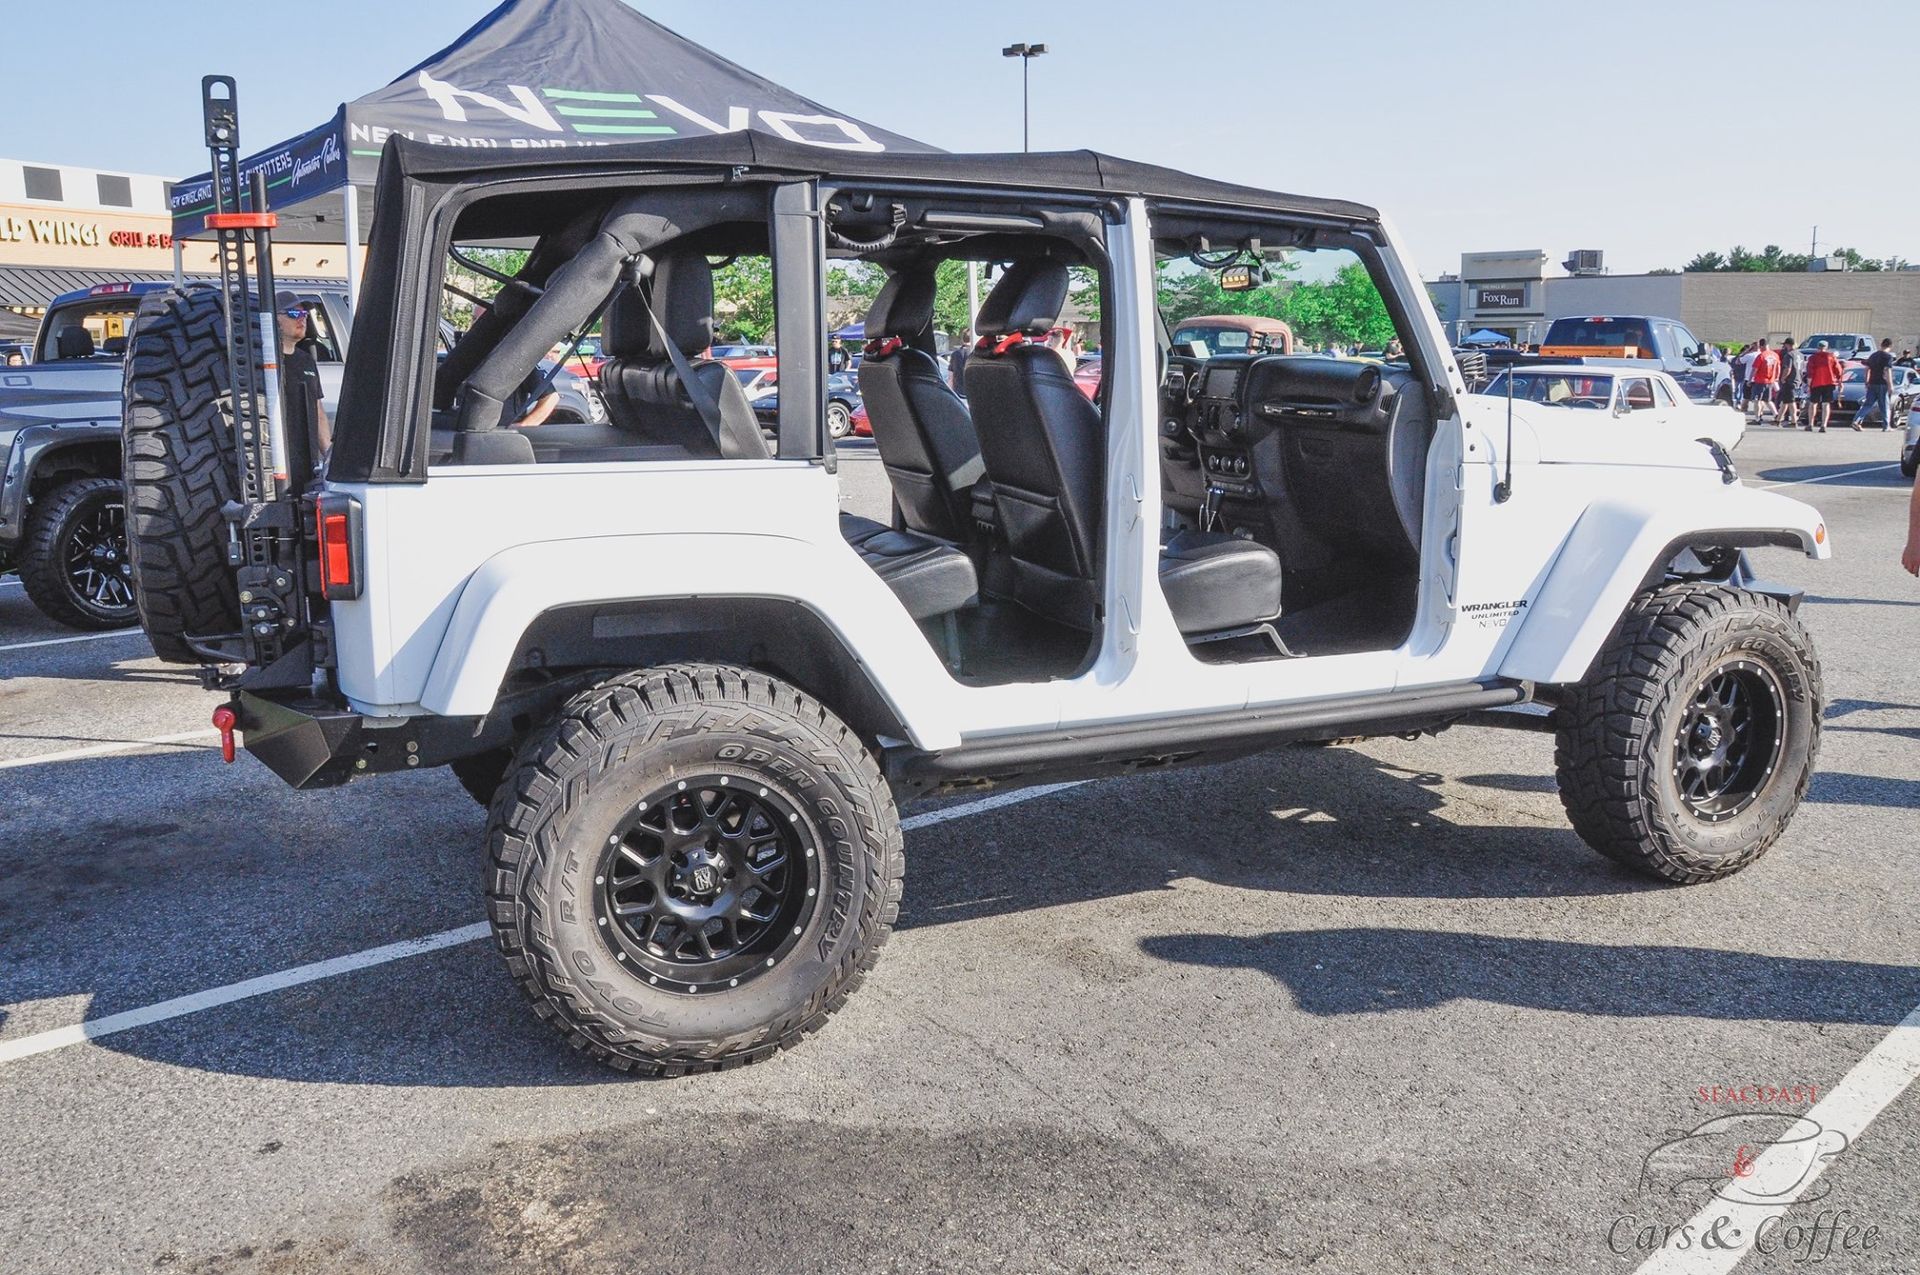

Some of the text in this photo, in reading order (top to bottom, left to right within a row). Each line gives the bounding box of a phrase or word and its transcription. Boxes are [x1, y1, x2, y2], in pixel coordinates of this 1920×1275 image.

[245, 151, 293, 185] OTFITTERS
[109, 231, 145, 248] GRILL
[1482, 292, 1519, 305] Fox Run
[1461, 600, 1528, 613] WRANGLER
[1471, 610, 1520, 620] UNLIMITED
[714, 743, 819, 789] OPEN
[816, 797, 855, 963] COUNTRY
[559, 849, 581, 925] R/T
[571, 949, 670, 1029] TOYO
